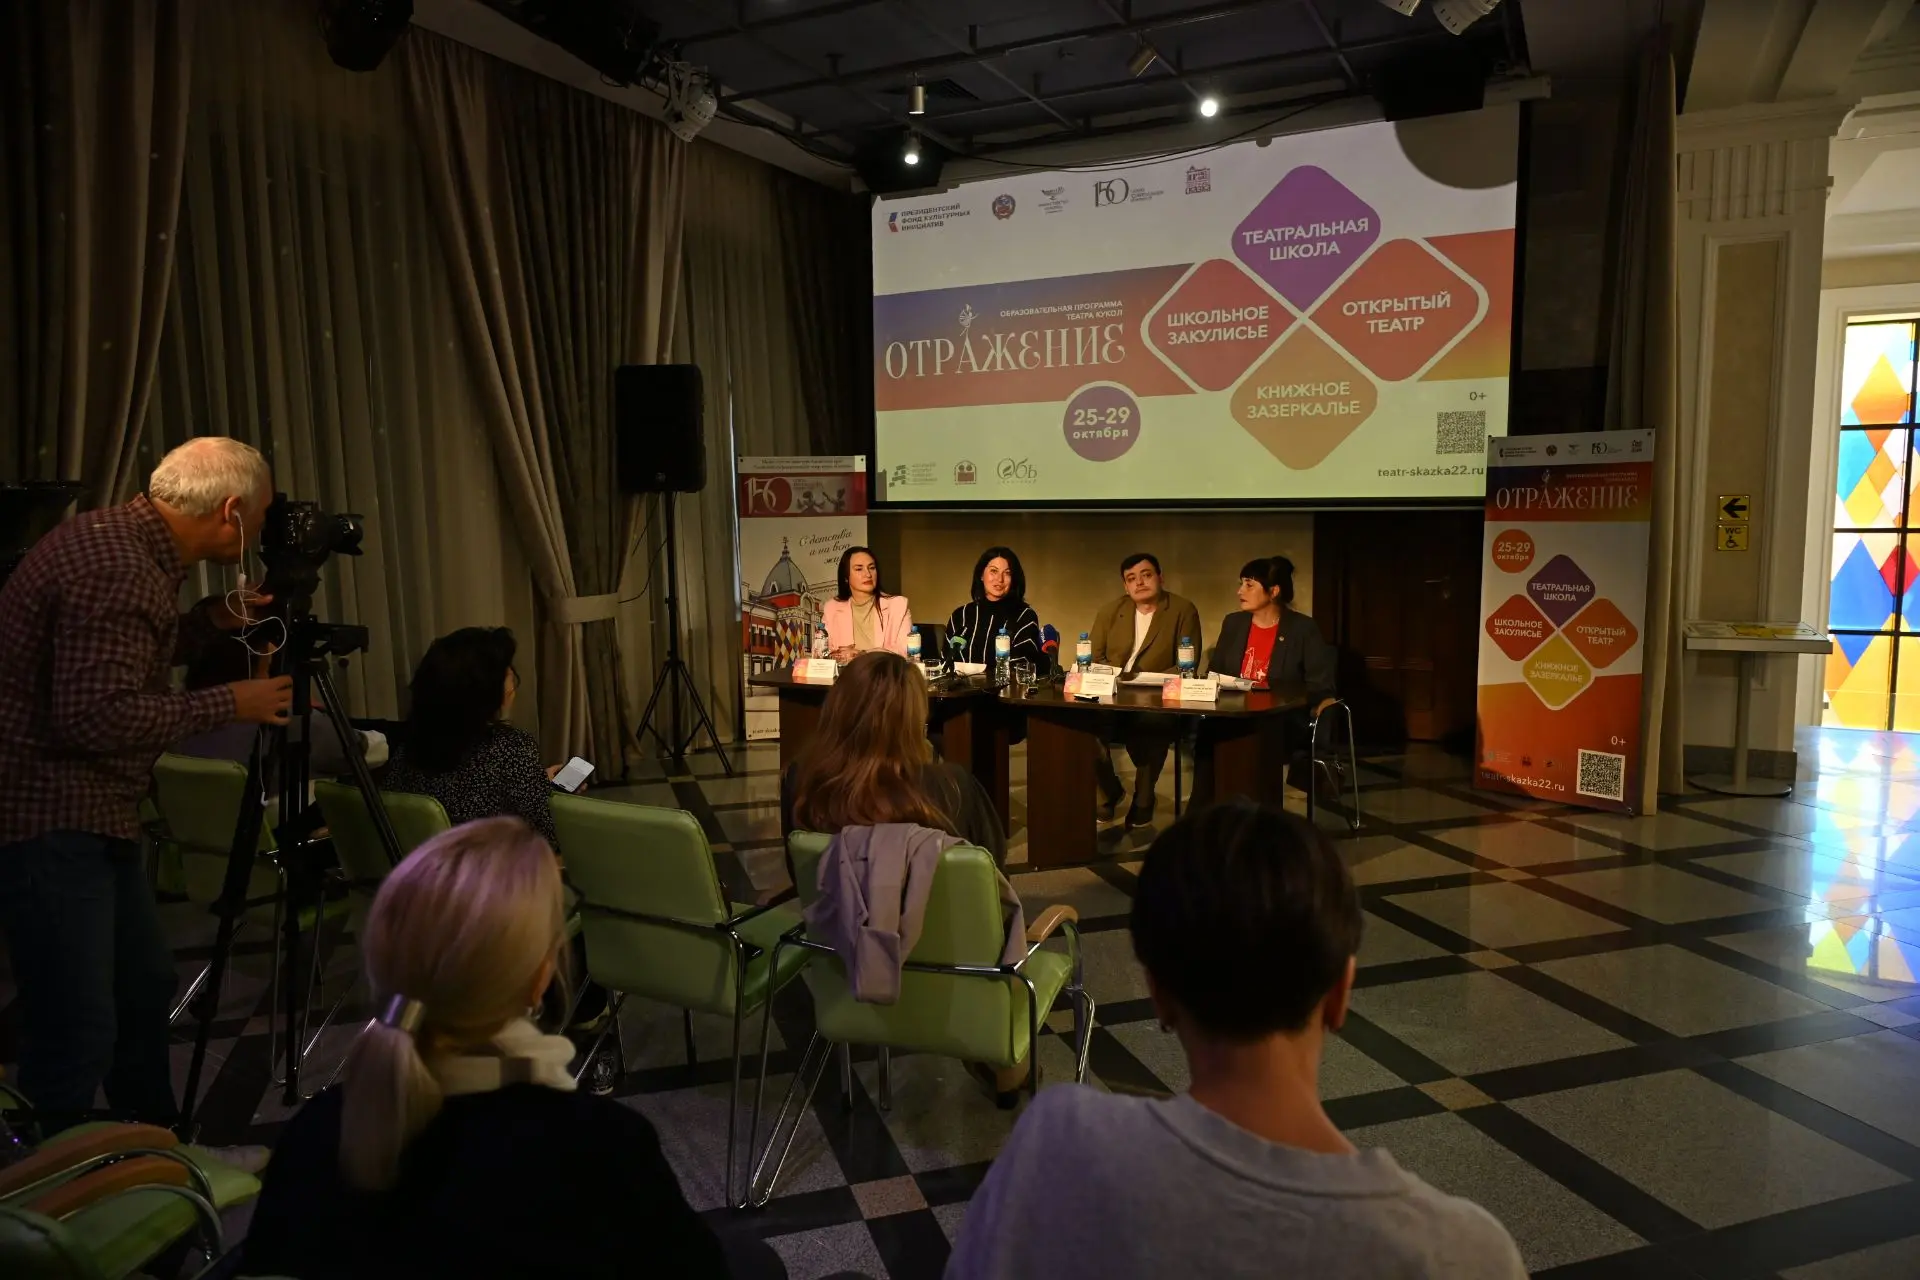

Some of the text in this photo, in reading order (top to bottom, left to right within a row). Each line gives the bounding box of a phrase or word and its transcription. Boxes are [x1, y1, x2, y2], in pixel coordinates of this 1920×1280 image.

[1093, 177, 1129, 207] 150
[901, 203, 961, 217] ПРЕЗИДЕНТСКИЙ
[924, 210, 970, 222] КУЛЬТУРНЫХ
[901, 221, 944, 231] ИНИЦИАТИВ
[1242, 218, 1369, 245] ТЕАТРАЛЬНАЯ
[1269, 241, 1341, 261] ШКОЛА
[1000, 300, 1123, 317] ОБРАЗОВАТЕЛЬНАЯ ПРОГРАММА
[1342, 292, 1451, 316] ОТКРЫТЫЙ
[1066, 309, 1123, 321] ТЕАТРА КУКОЛ
[1167, 306, 1269, 327] ШКОЛЬНОЕ
[1366, 317, 1425, 334] ТЕАТР
[1167, 325, 1268, 345] ЗАКУЛИСЬЕ
[885, 323, 1126, 379] ОТРАЖЕНИЕ
[1257, 382, 1351, 400] КНИЖНОЕ
[1469, 391, 1487, 401] 0+
[1073, 407, 1132, 426] 25-29
[1247, 401, 1360, 419] ЗАЗЕРКАЛЬЕ
[1073, 427, 1129, 440] октября
[1377, 465, 1484, 477] teatr-skazka22.ru
[1498, 542, 1531, 553] 25-29
[1532, 582, 1590, 593] ТЕАТРАЛЬНАЯ
[1543, 593, 1577, 602] ШКОЛА
[1494, 618, 1543, 629] ШКОЛЬНОЕ
[1494, 627, 1542, 638] ЗАКУЛИСЬЕ
[1576, 625, 1626, 636] ОТКРЫТЫЙ
[1588, 636, 1614, 646] ТЕАТР
[1535, 661, 1579, 673] КНИЖНОЕ
[1530, 669, 1583, 682] ЗАЗЕРКАЛЬЕ
[1611, 735, 1626, 746] 0+
